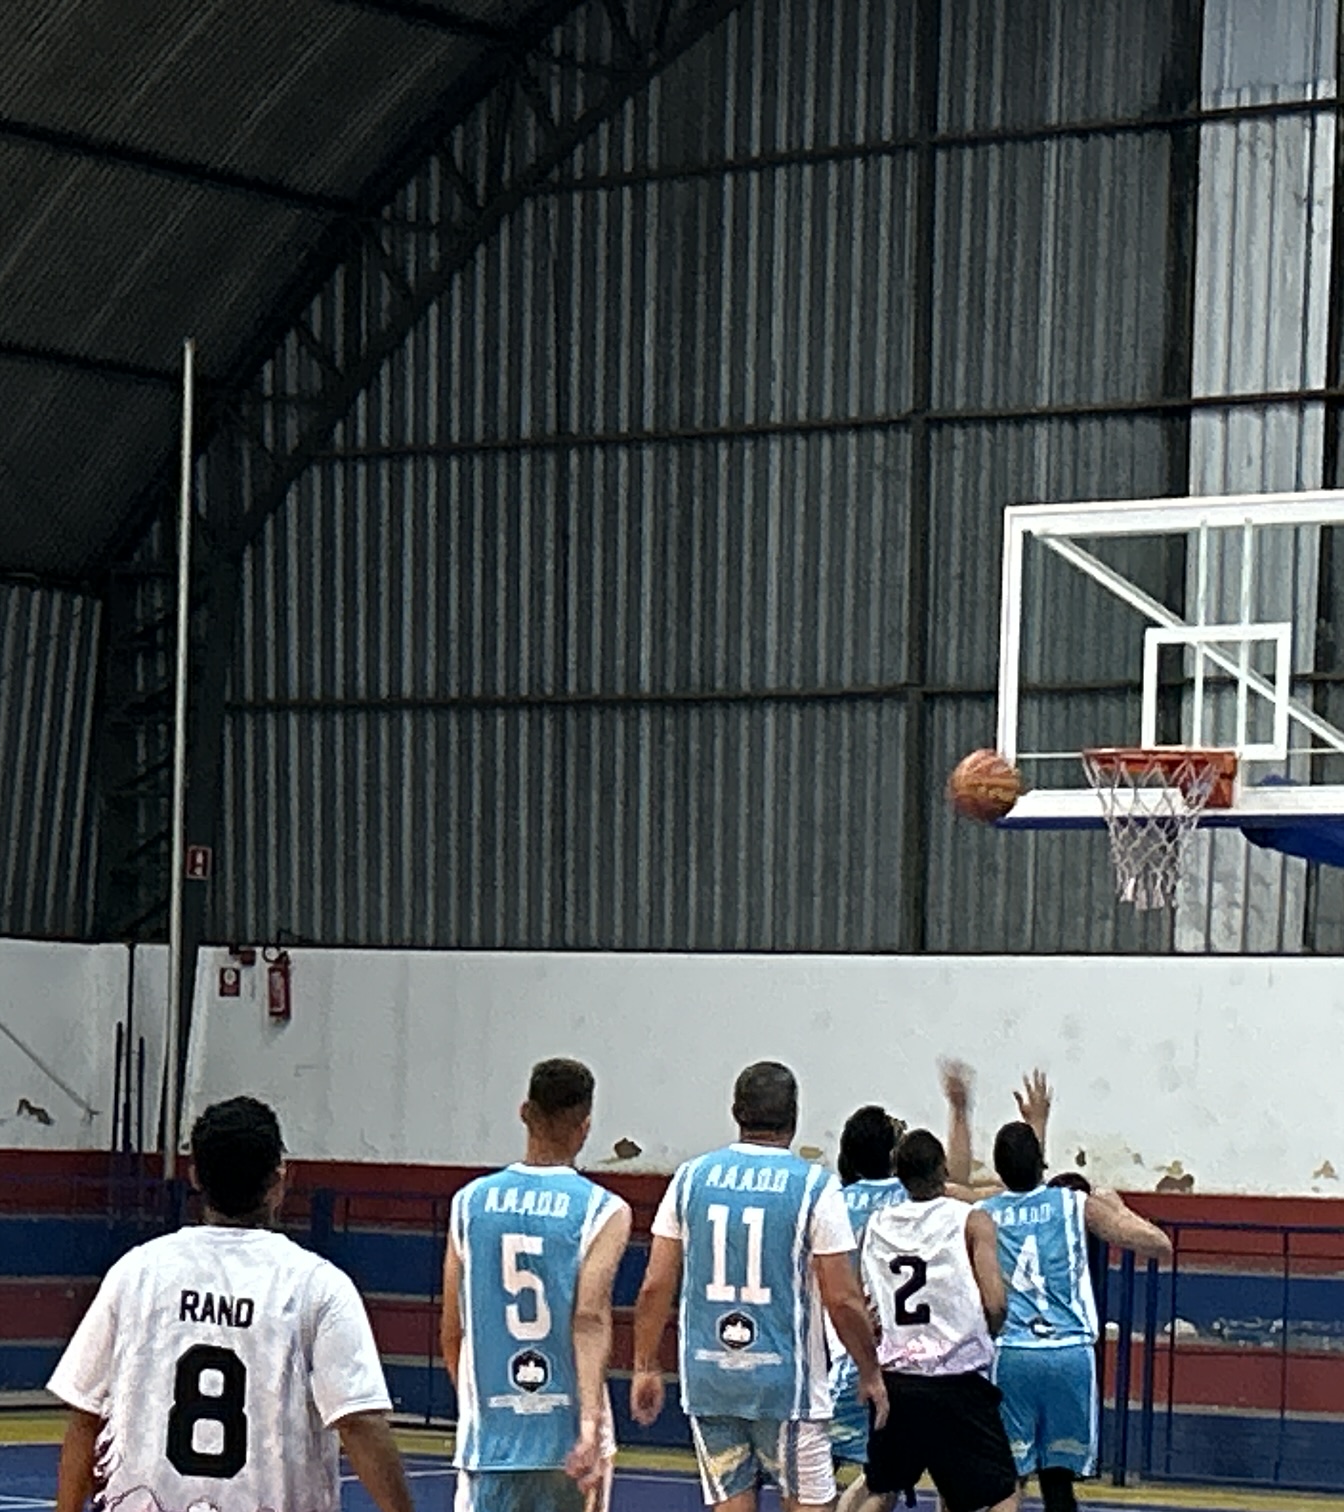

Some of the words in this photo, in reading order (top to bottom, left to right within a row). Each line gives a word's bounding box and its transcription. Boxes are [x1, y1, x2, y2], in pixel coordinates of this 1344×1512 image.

[501, 1233, 552, 1341] 5
[706, 1204, 772, 1305] 11
[889, 1256, 931, 1325] 2
[1012, 1235, 1049, 1310] 4
[165, 1343, 247, 1479] 8
